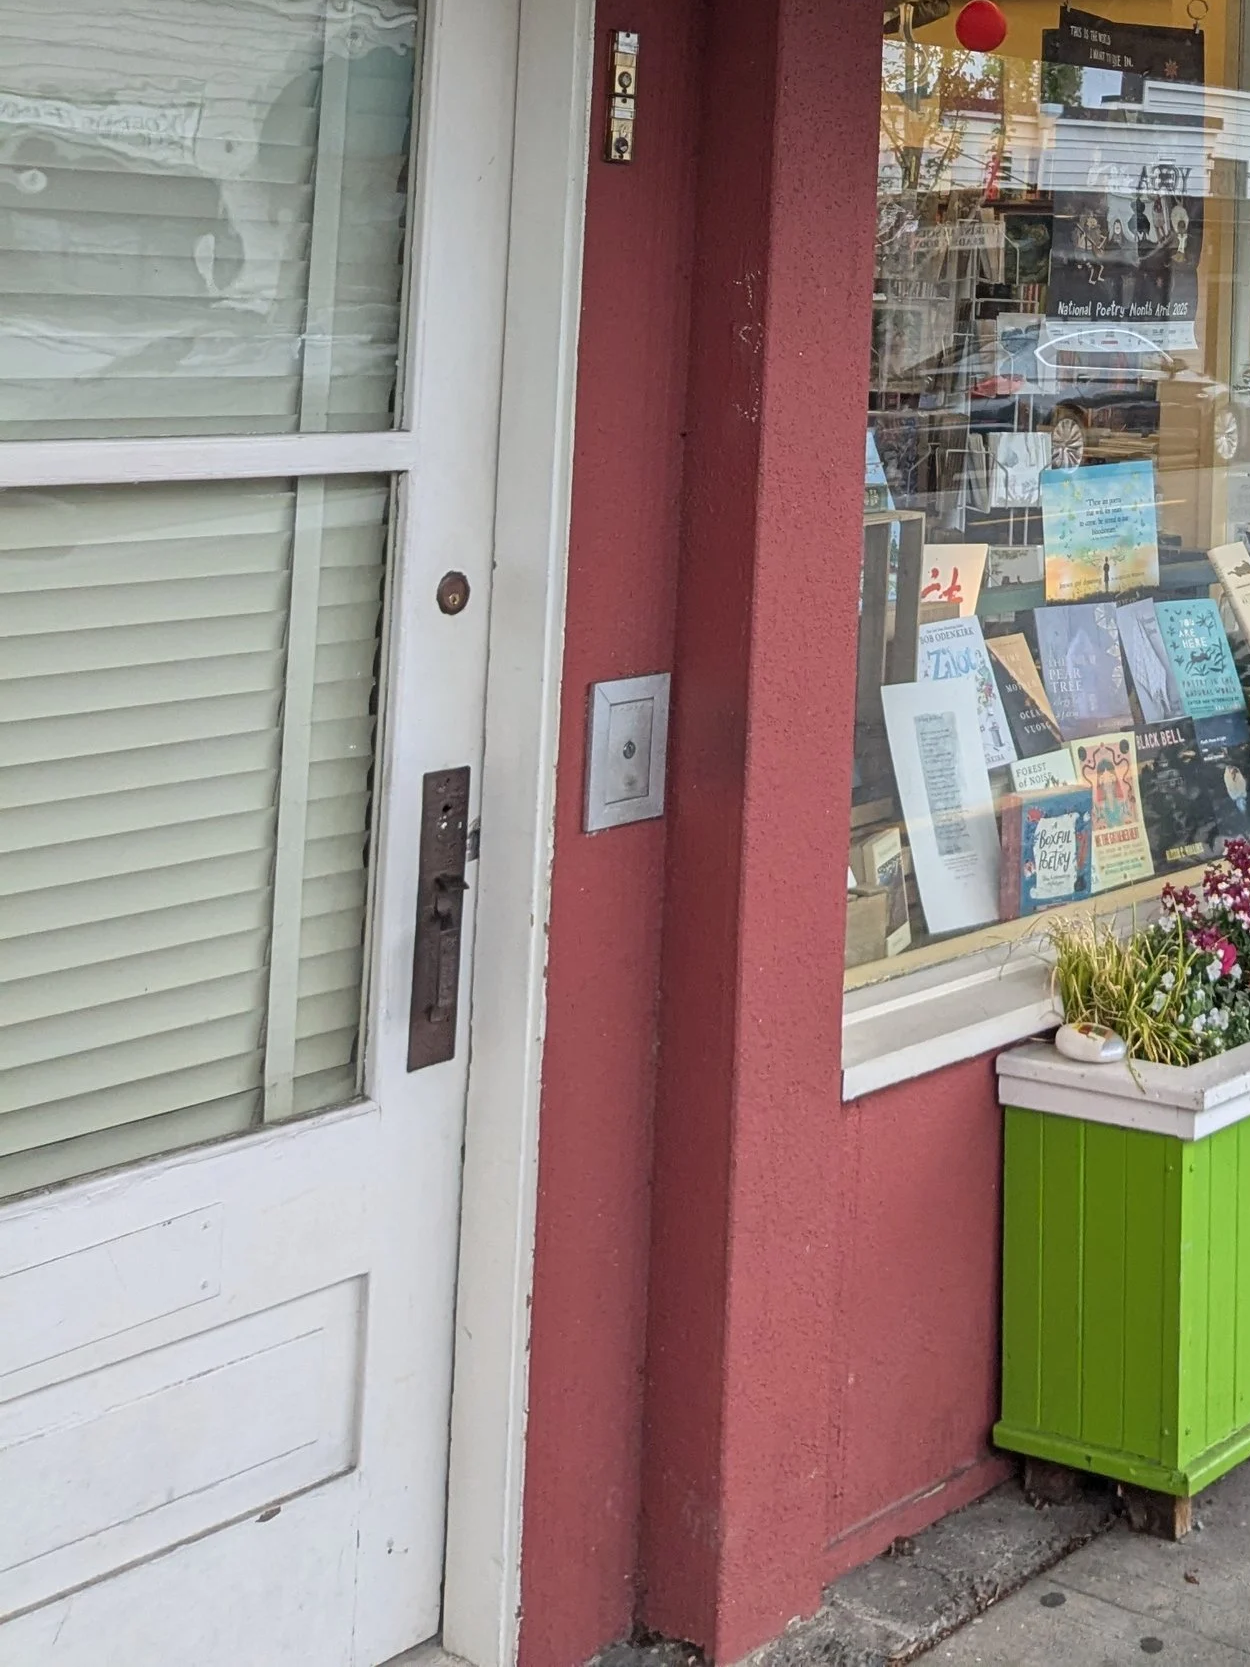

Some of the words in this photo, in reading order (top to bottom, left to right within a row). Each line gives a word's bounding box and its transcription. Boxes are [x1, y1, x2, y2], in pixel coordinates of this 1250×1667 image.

[1057, 300, 1092, 316] National
[1096, 300, 1125, 318] Poetry
[1129, 302, 1153, 316] Month
[1155, 302, 1171, 317] April
[1172, 302, 1189, 317] 2025
[919, 634, 934, 645] BOB
[935, 627, 975, 642] ODENKIRK
[1178, 628, 1196, 638] ARE
[1182, 636, 1207, 648] HERE
[1049, 667, 1082, 680] PEAR
[1051, 679, 1083, 694] TREE
[1136, 731, 1160, 750] BLACK
[1161, 728, 1186, 746] BELL
[1016, 762, 1046, 778] FOREST
[1019, 778, 1028, 788] of
